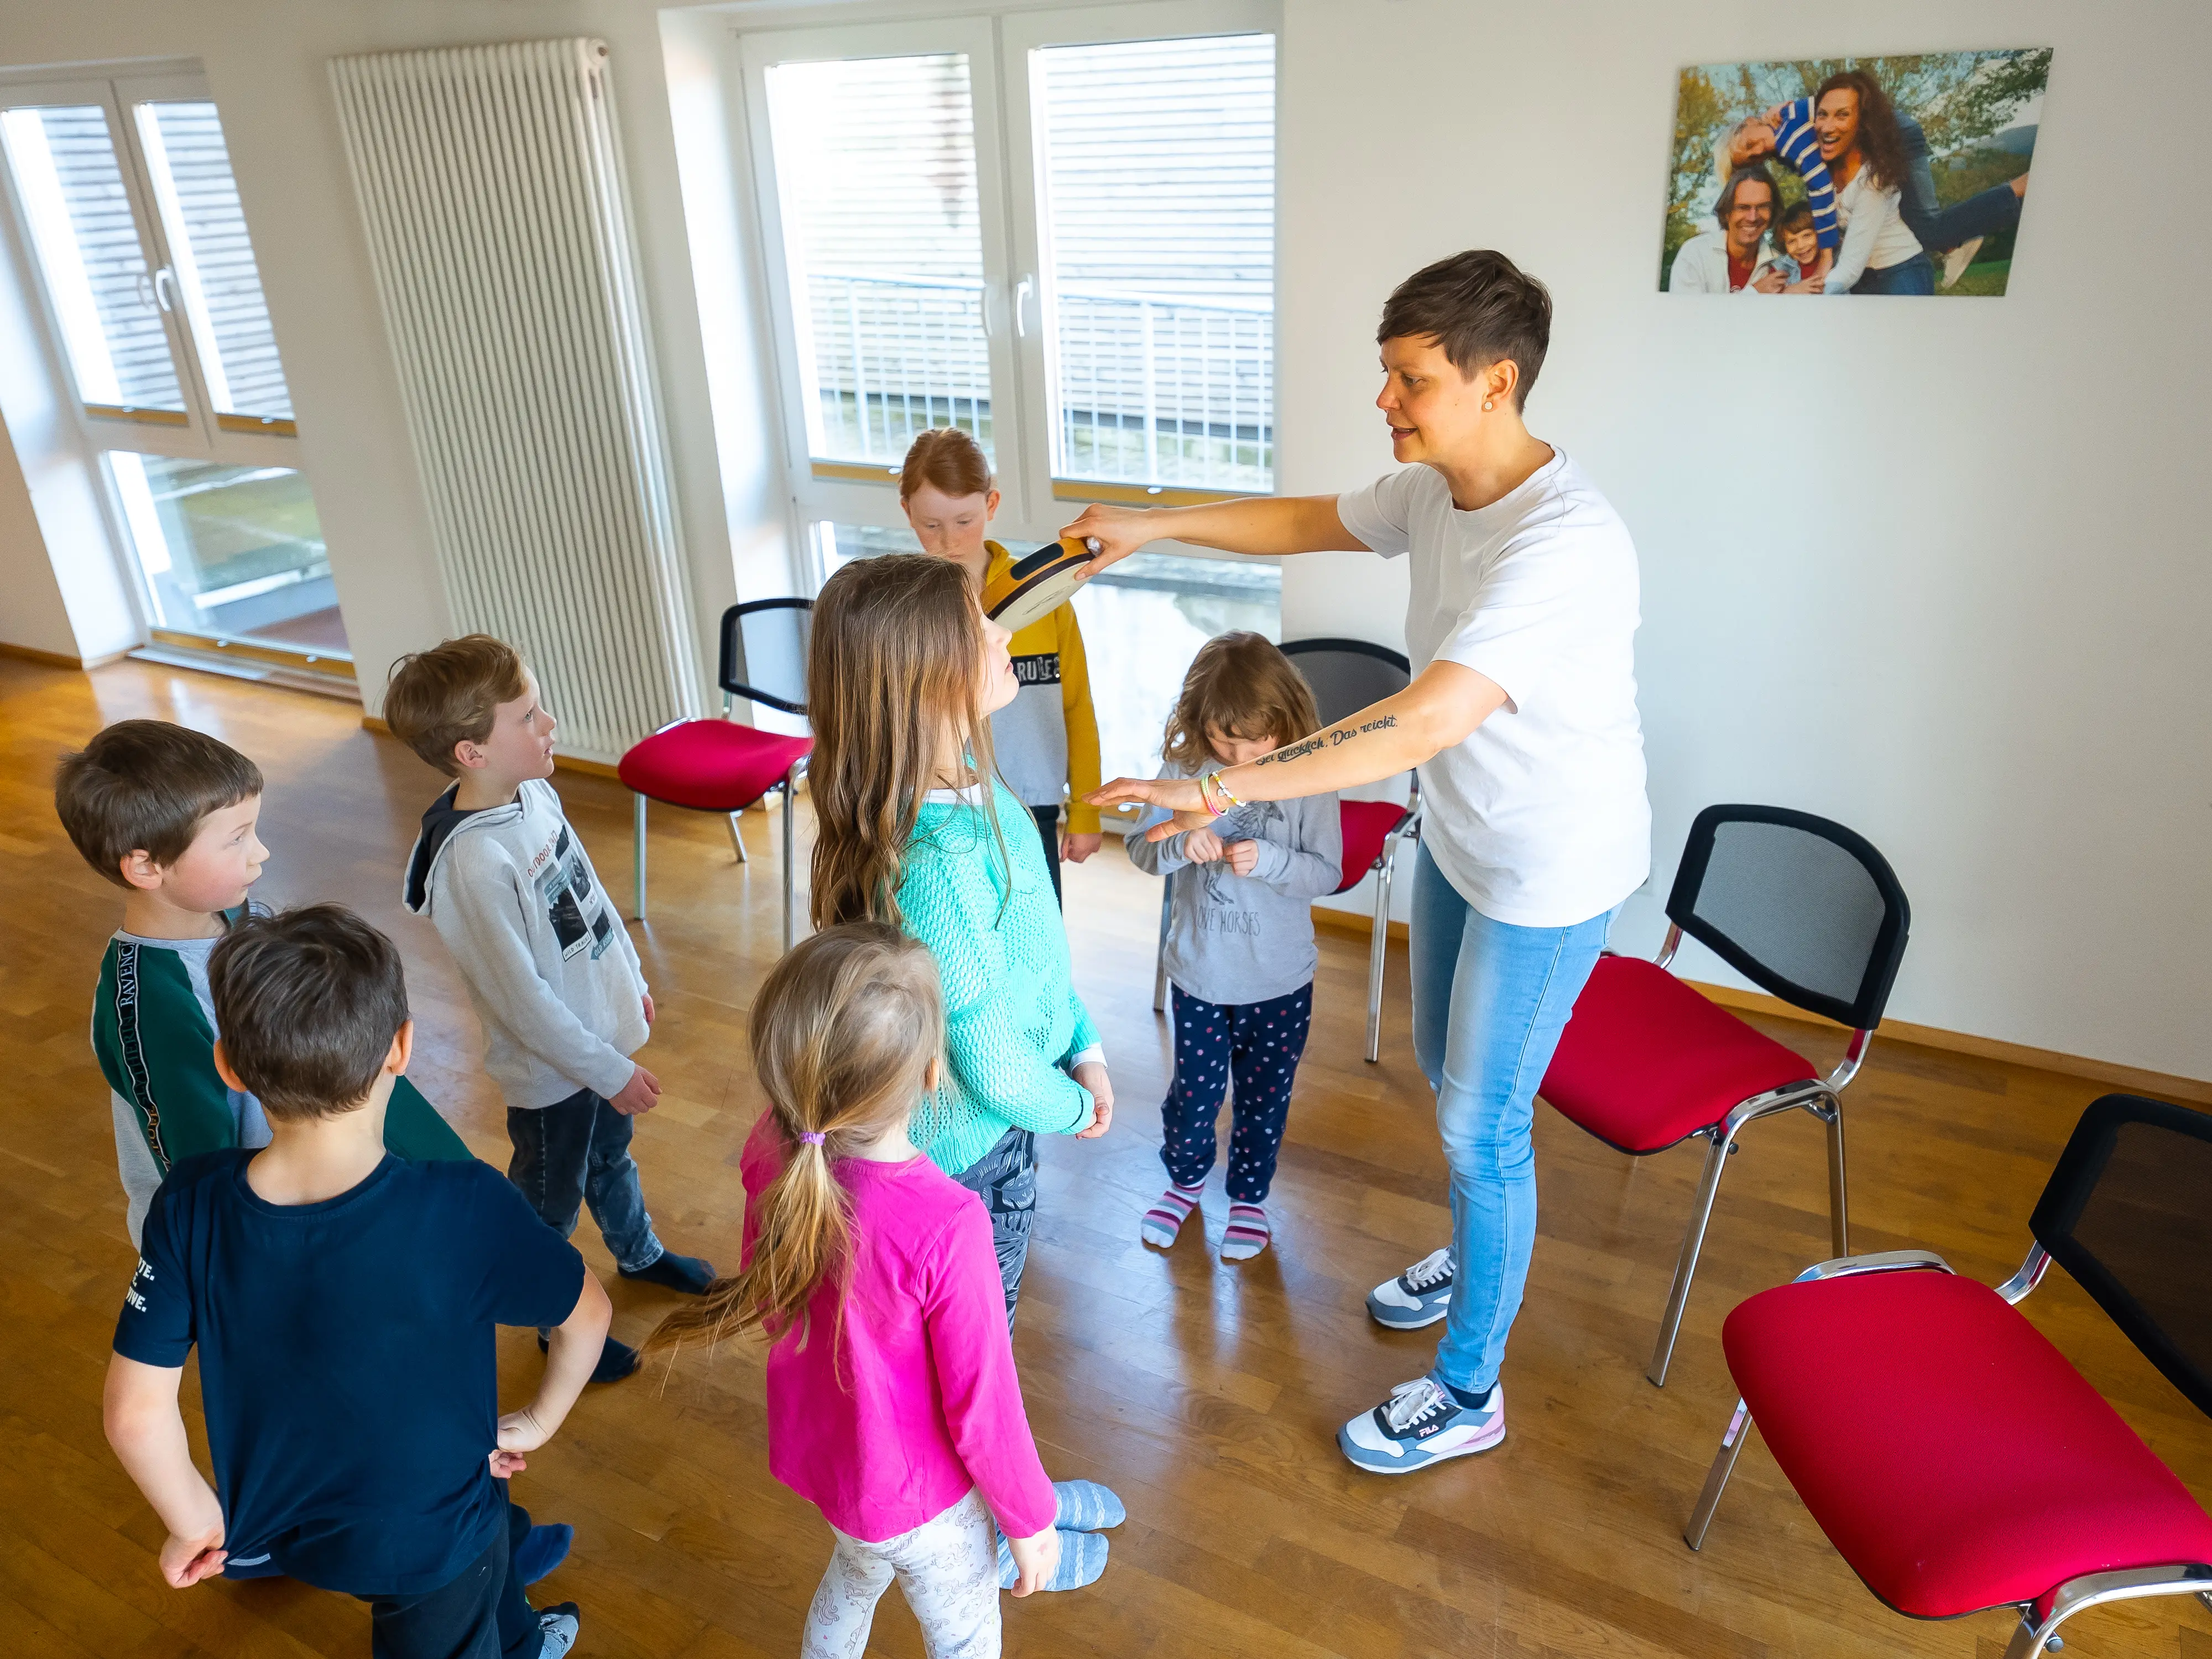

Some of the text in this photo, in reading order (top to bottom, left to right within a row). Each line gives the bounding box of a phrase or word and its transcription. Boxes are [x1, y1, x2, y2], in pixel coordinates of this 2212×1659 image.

[1329, 728, 1357, 745] Das
[1360, 714, 1397, 733] reicht.
[528, 844, 551, 878] OUTDOOR
[1220, 910, 1261, 936] HORSES
[594, 945, 603, 957] OLD
[1418, 1424, 1439, 1437] FILA
